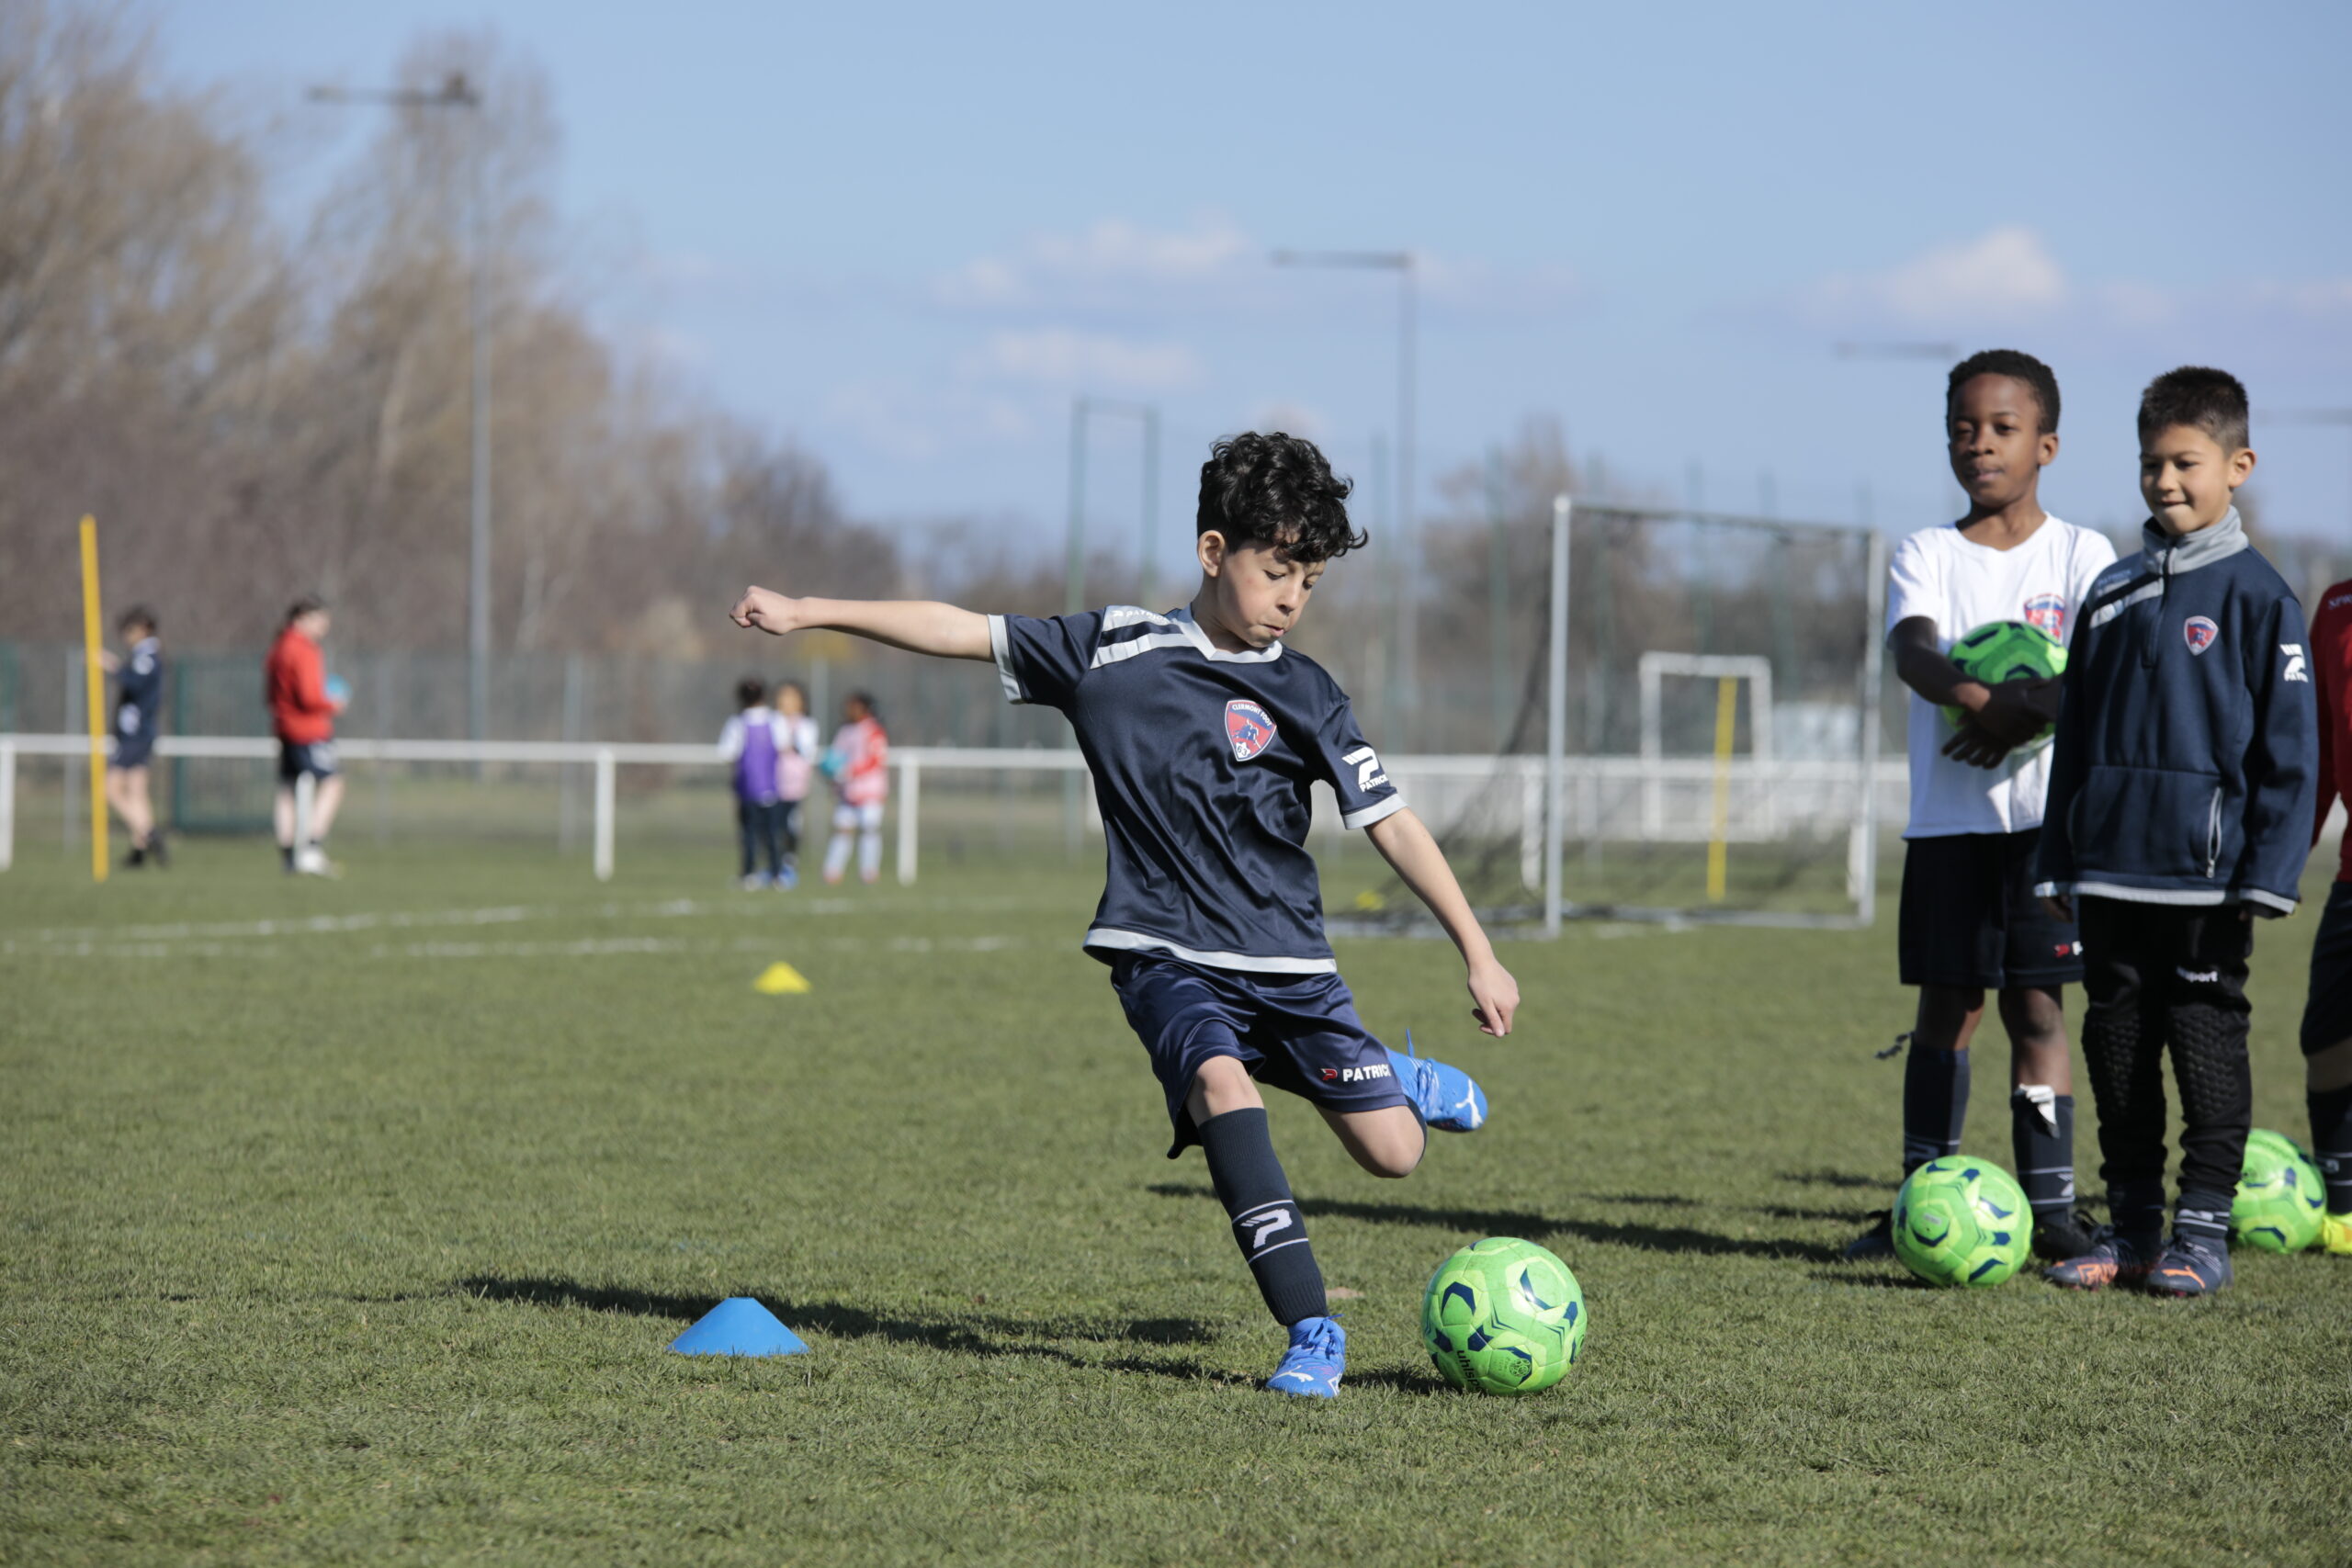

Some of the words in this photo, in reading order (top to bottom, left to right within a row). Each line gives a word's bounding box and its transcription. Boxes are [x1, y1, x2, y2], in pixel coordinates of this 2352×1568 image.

[1232, 704, 1261, 714] CLERMONT
[1261, 712, 1272, 726] FOOT
[1237, 745, 1248, 756] 63
